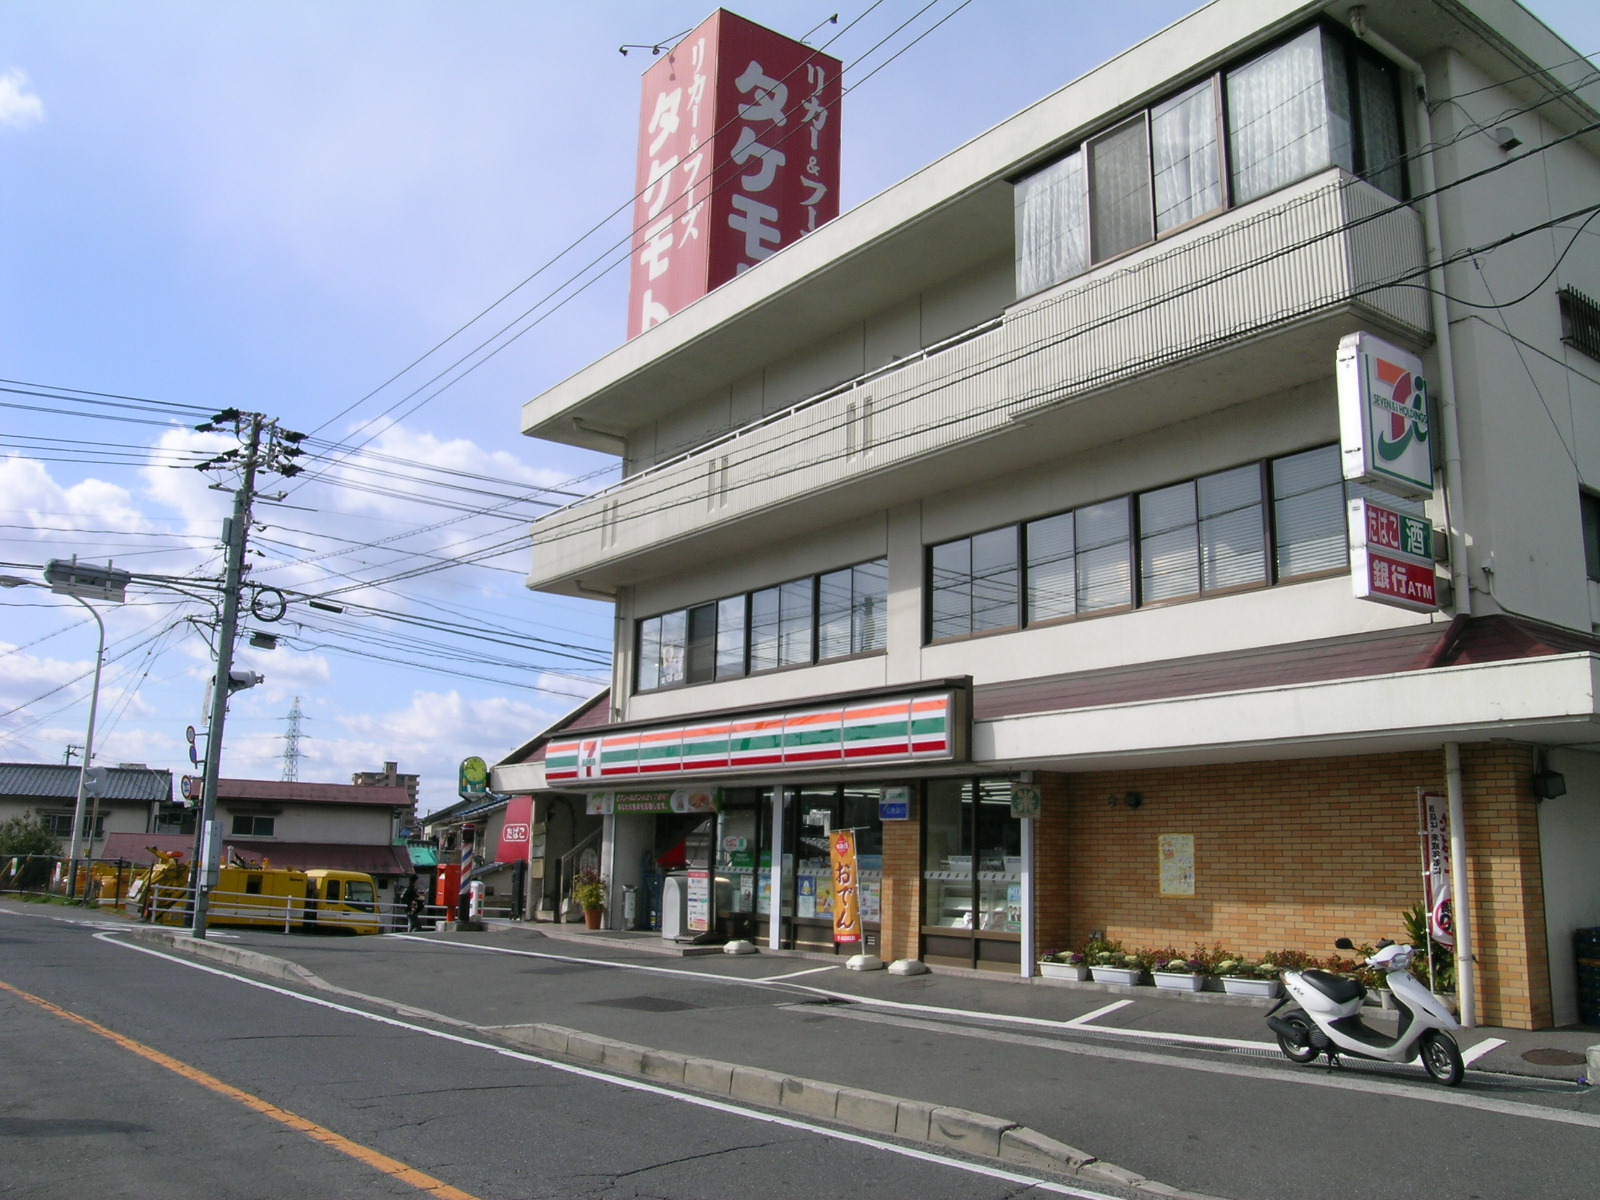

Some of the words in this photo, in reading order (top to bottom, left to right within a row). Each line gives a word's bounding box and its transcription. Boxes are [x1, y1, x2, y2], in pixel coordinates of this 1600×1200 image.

[678, 38, 706, 248] リカー&フーズ
[728, 60, 788, 276] タケモ
[800, 63, 828, 238] リカー&フー
[1399, 404, 1428, 424] HOLDINGS
[1367, 507, 1399, 548] たばこ
[1406, 518, 1425, 555] 酒
[506, 825, 525, 839] たばこ
[835, 861, 855, 931] おでん
